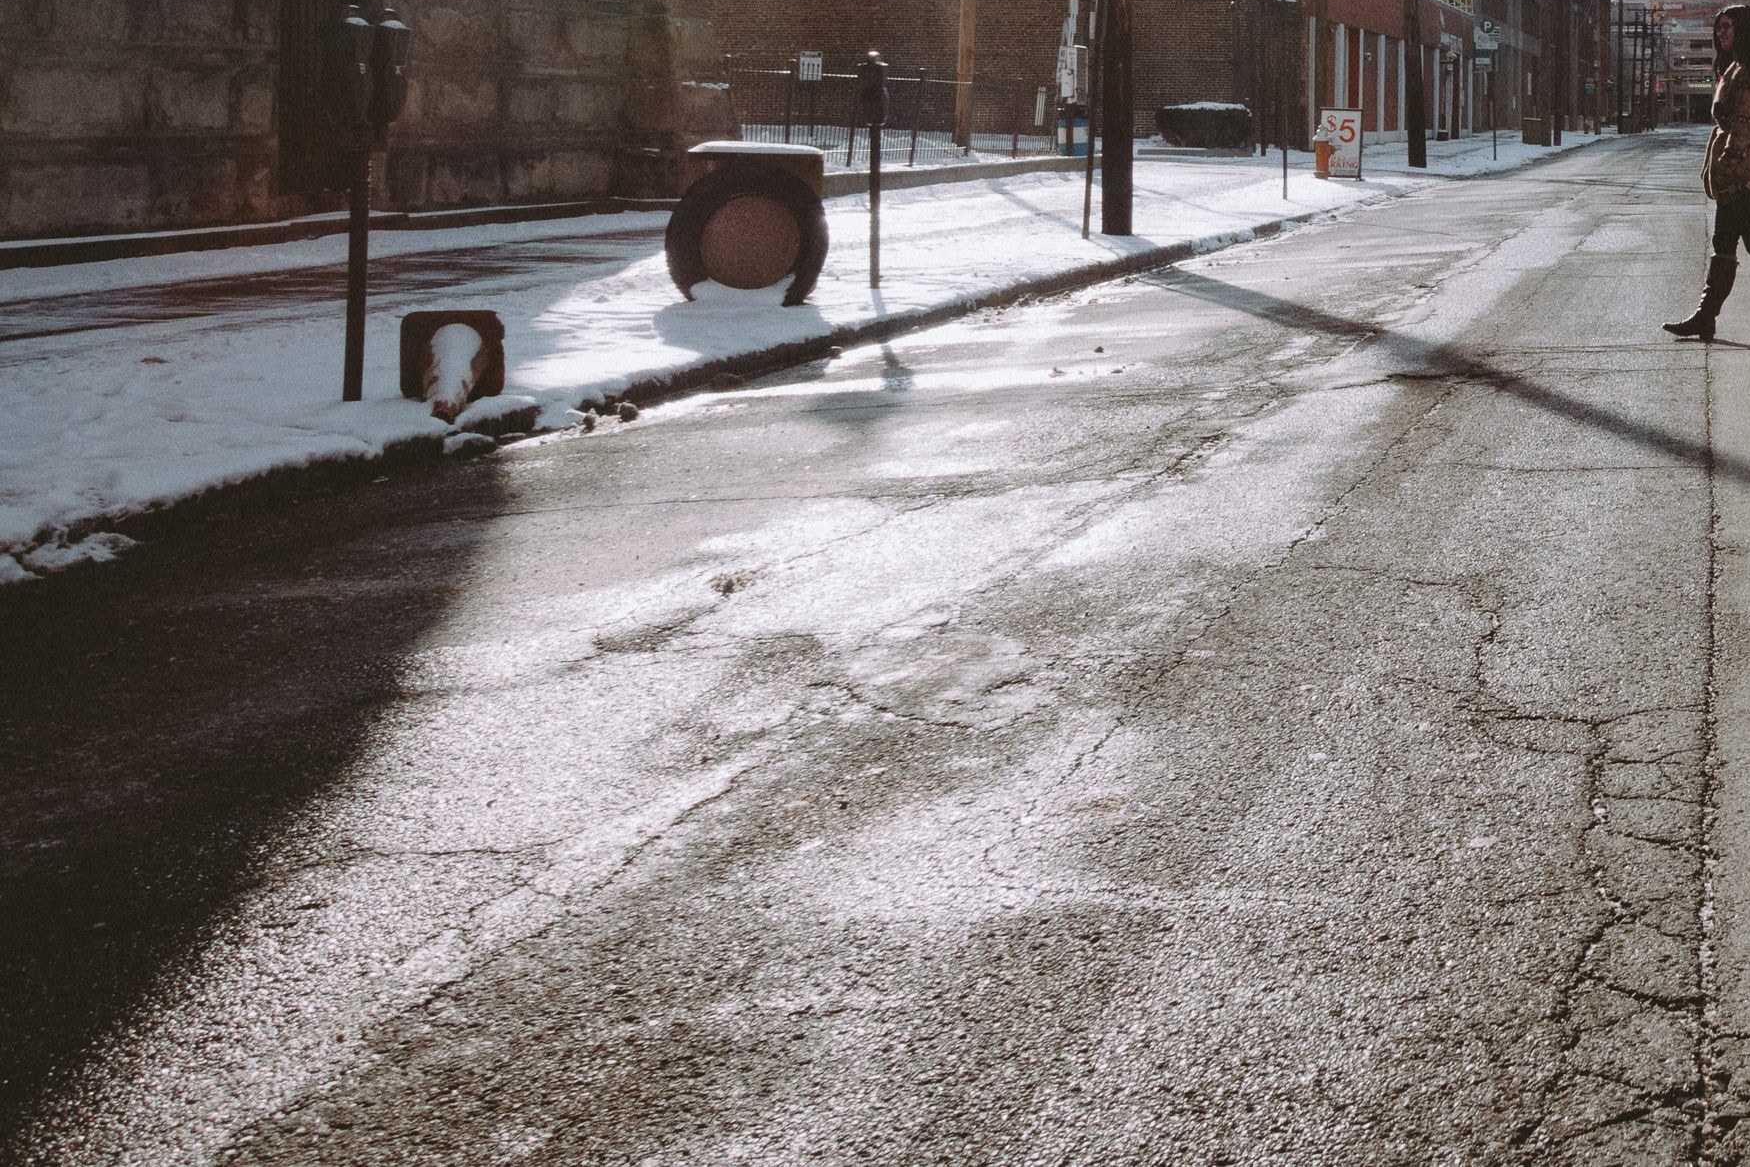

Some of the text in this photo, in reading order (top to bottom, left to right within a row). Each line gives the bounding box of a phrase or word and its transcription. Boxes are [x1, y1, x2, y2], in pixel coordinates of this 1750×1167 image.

[1484, 21, 1492, 32] P
[1327, 115, 1356, 143] $5
[1330, 161, 1358, 170] RKING
